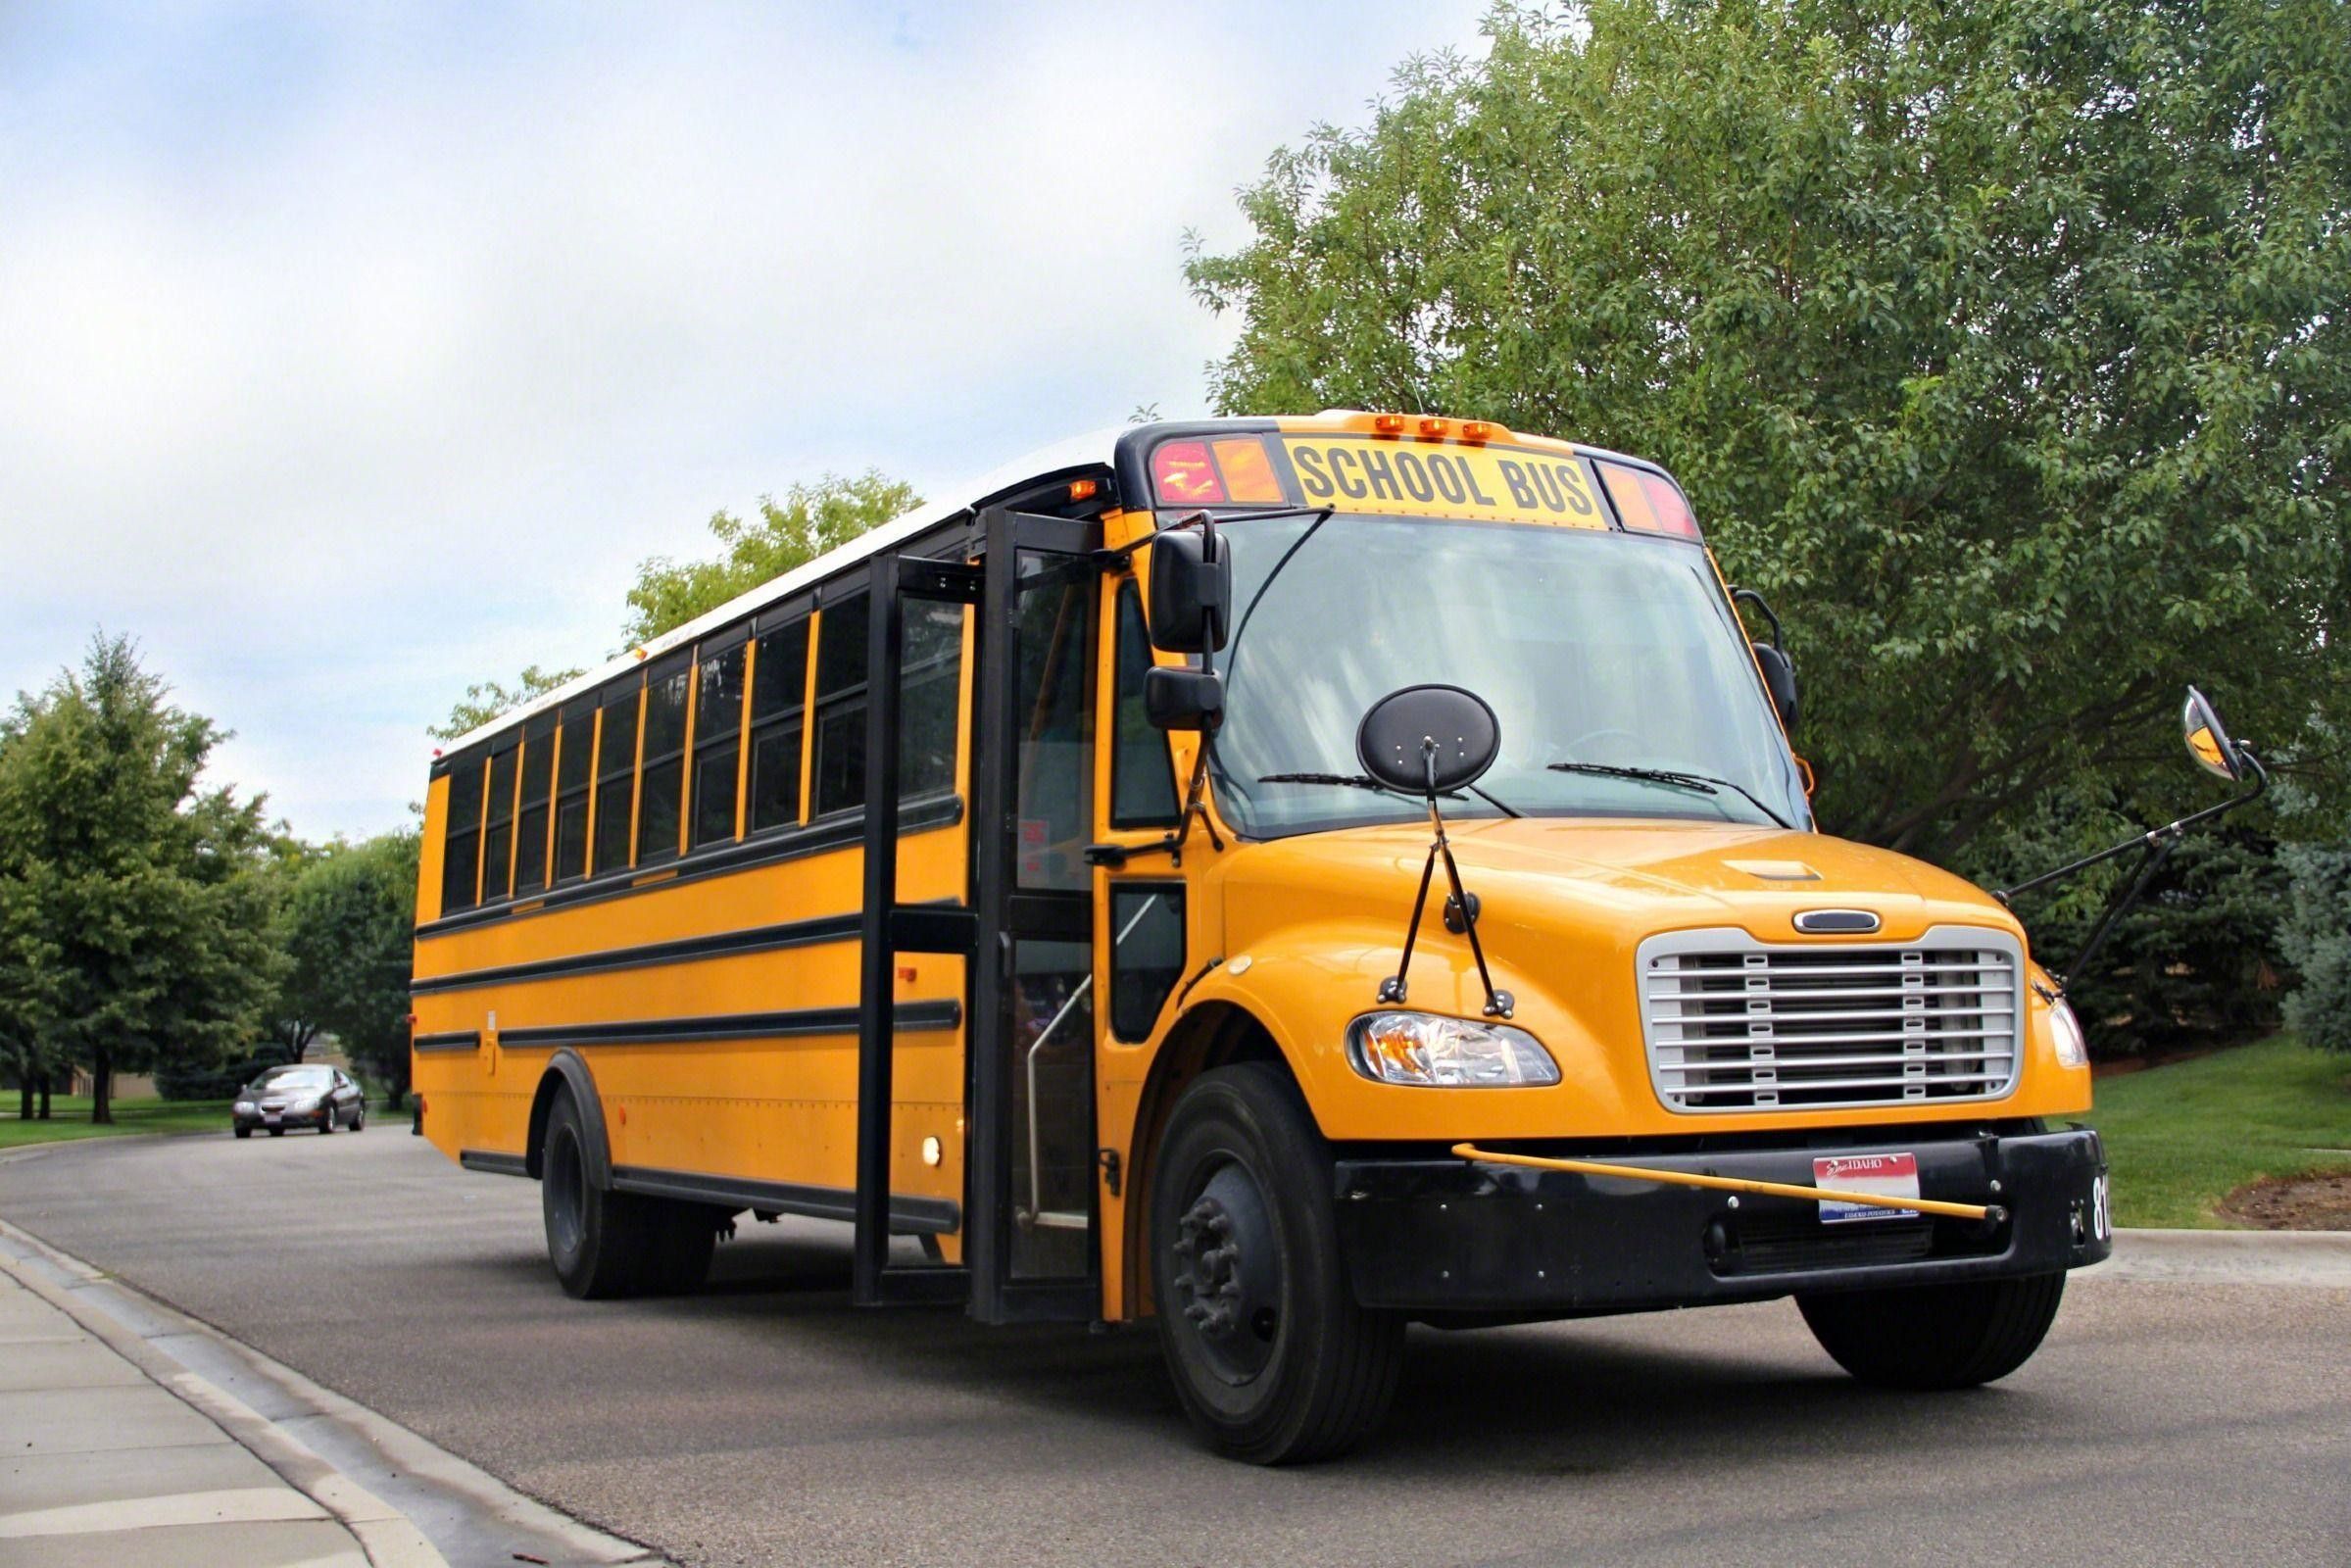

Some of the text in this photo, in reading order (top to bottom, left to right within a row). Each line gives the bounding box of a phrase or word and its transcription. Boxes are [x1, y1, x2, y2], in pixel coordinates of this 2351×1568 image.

[1294, 446, 1592, 515] SCHOOL BUS
[1848, 1159, 1882, 1170] IDAHO
